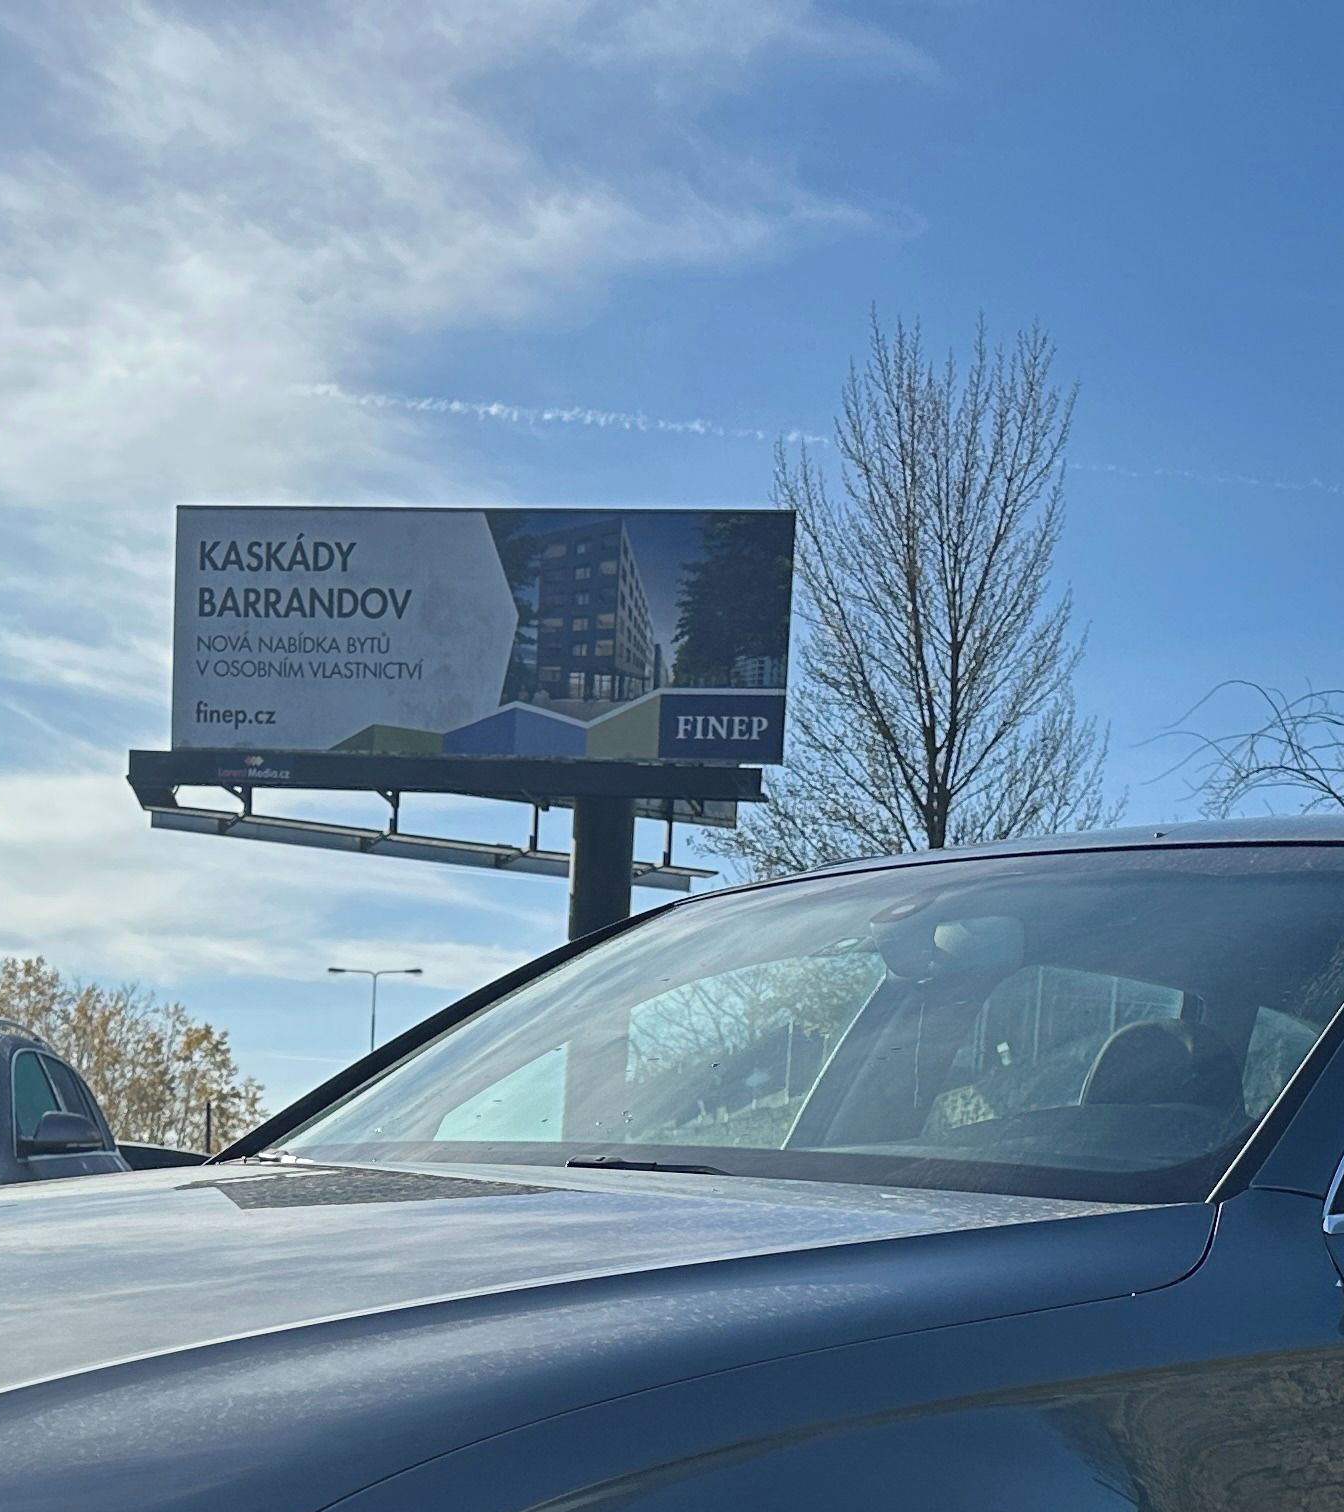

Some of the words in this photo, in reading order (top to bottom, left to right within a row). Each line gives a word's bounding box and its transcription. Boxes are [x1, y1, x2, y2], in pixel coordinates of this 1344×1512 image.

[199, 532, 357, 572] KASKÁDY
[198, 587, 412, 619] BARRANDOV
[196, 631, 253, 653] NOVÁ
[258, 632, 341, 654] NABÍDKA
[346, 632, 390, 654] BYTŮ
[195, 659, 209, 677] V
[213, 657, 305, 678] OSOBNÍM
[308, 658, 425, 680] VLASTNICTVÍ
[195, 701, 277, 730] finep.cz
[676, 715, 769, 740] FINEP
